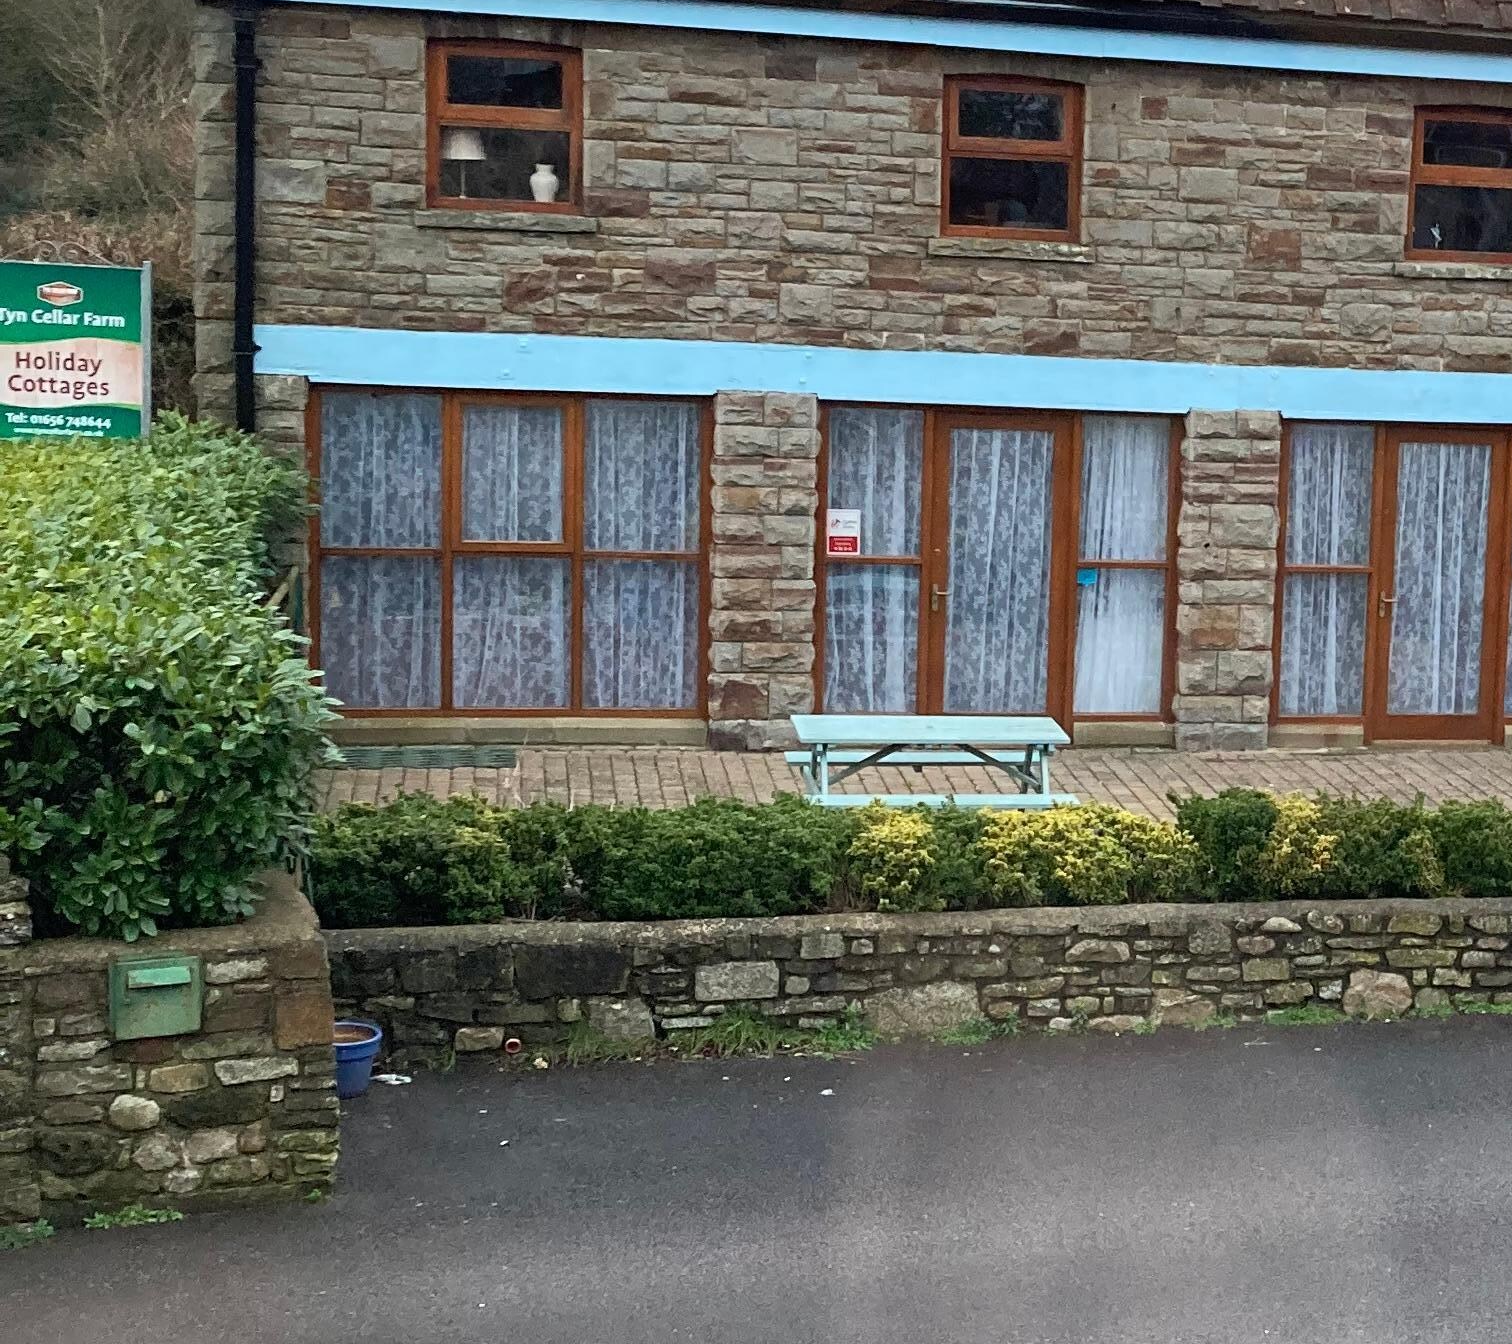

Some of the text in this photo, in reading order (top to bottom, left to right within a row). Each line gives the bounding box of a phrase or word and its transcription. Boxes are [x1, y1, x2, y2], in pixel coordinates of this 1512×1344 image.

[0, 308, 126, 327] Tyn Cellar Farm
[15, 351, 102, 377] Holiday
[8, 374, 109, 400] Cottages
[5, 412, 112, 429] Tel: 01656 748644
